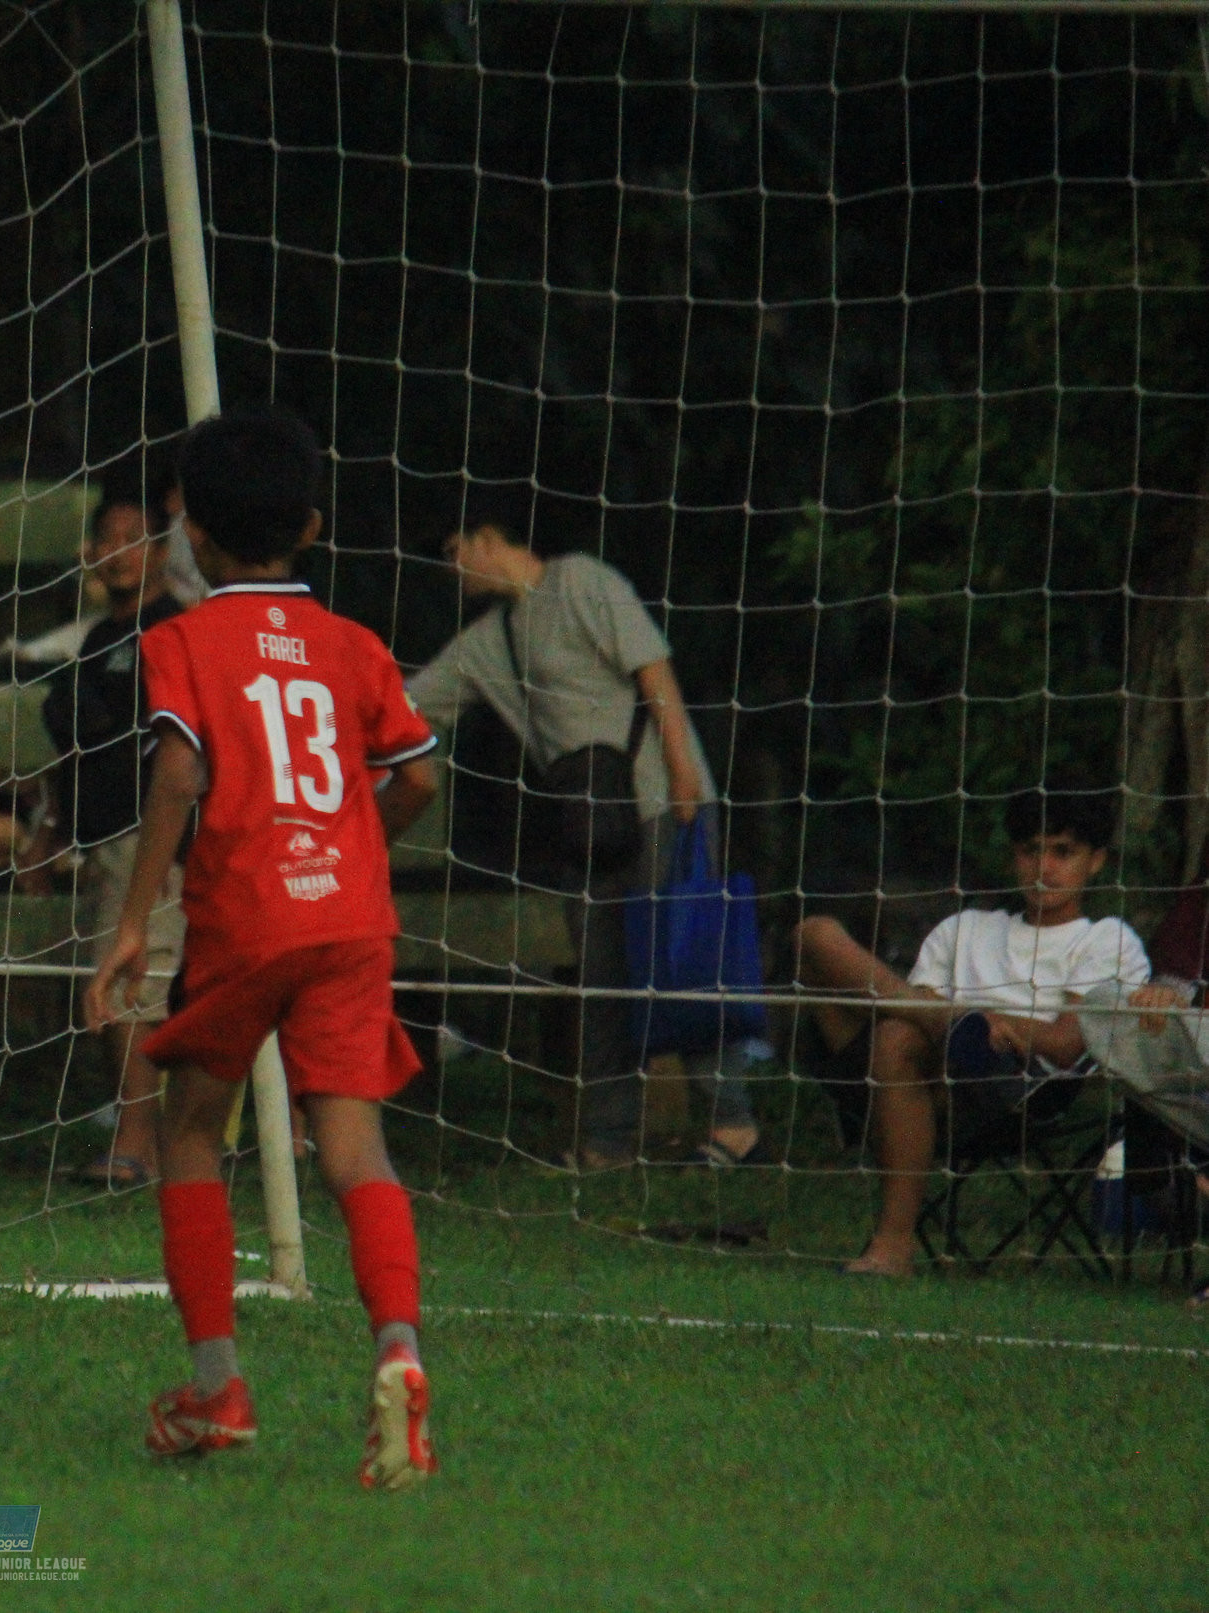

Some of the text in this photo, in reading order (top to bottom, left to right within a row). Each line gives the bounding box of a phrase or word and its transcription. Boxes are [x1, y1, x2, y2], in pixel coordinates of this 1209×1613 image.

[256, 632, 311, 666] FAREL
[243, 673, 344, 814] 13
[283, 872, 342, 899] YAMAHA
